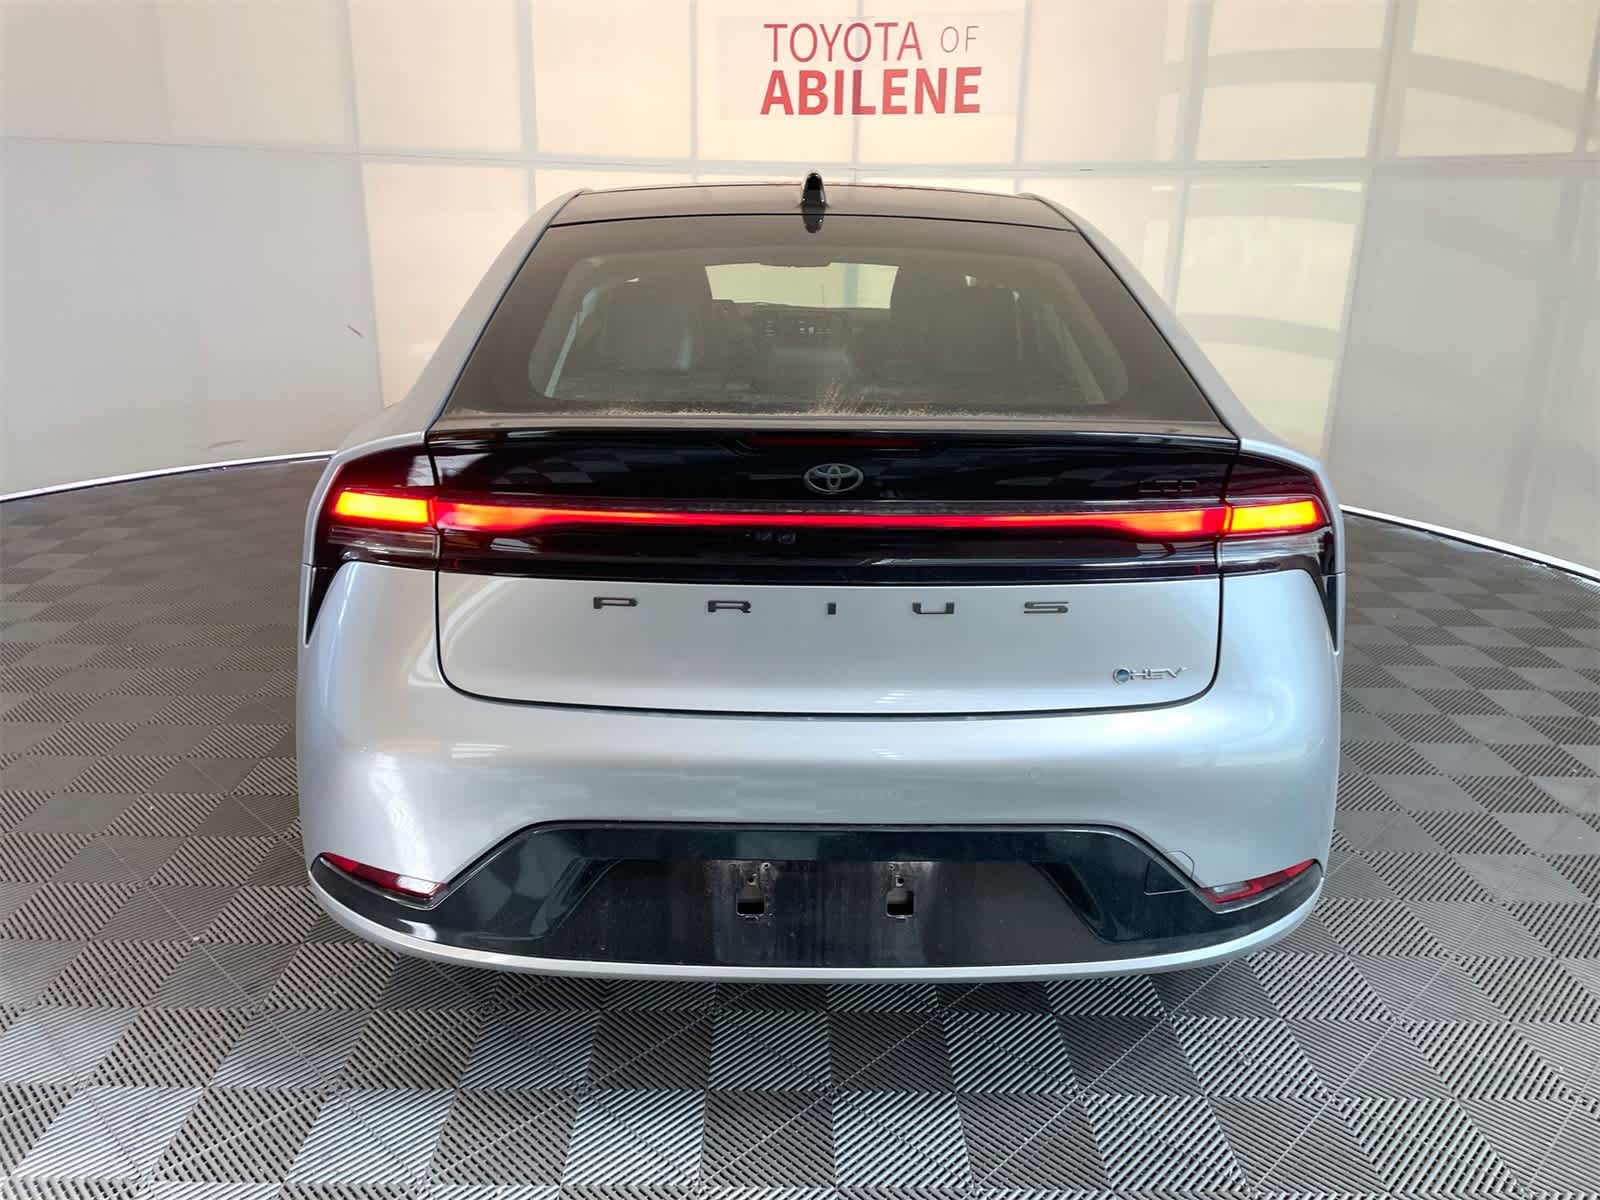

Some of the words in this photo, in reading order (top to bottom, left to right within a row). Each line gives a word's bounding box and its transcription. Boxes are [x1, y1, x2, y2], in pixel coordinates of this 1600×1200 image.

[763, 21, 923, 62] TOYOTA
[940, 25, 979, 53] OF
[760, 66, 982, 115] ABILENE
[593, 596, 1069, 615] PRIUS
